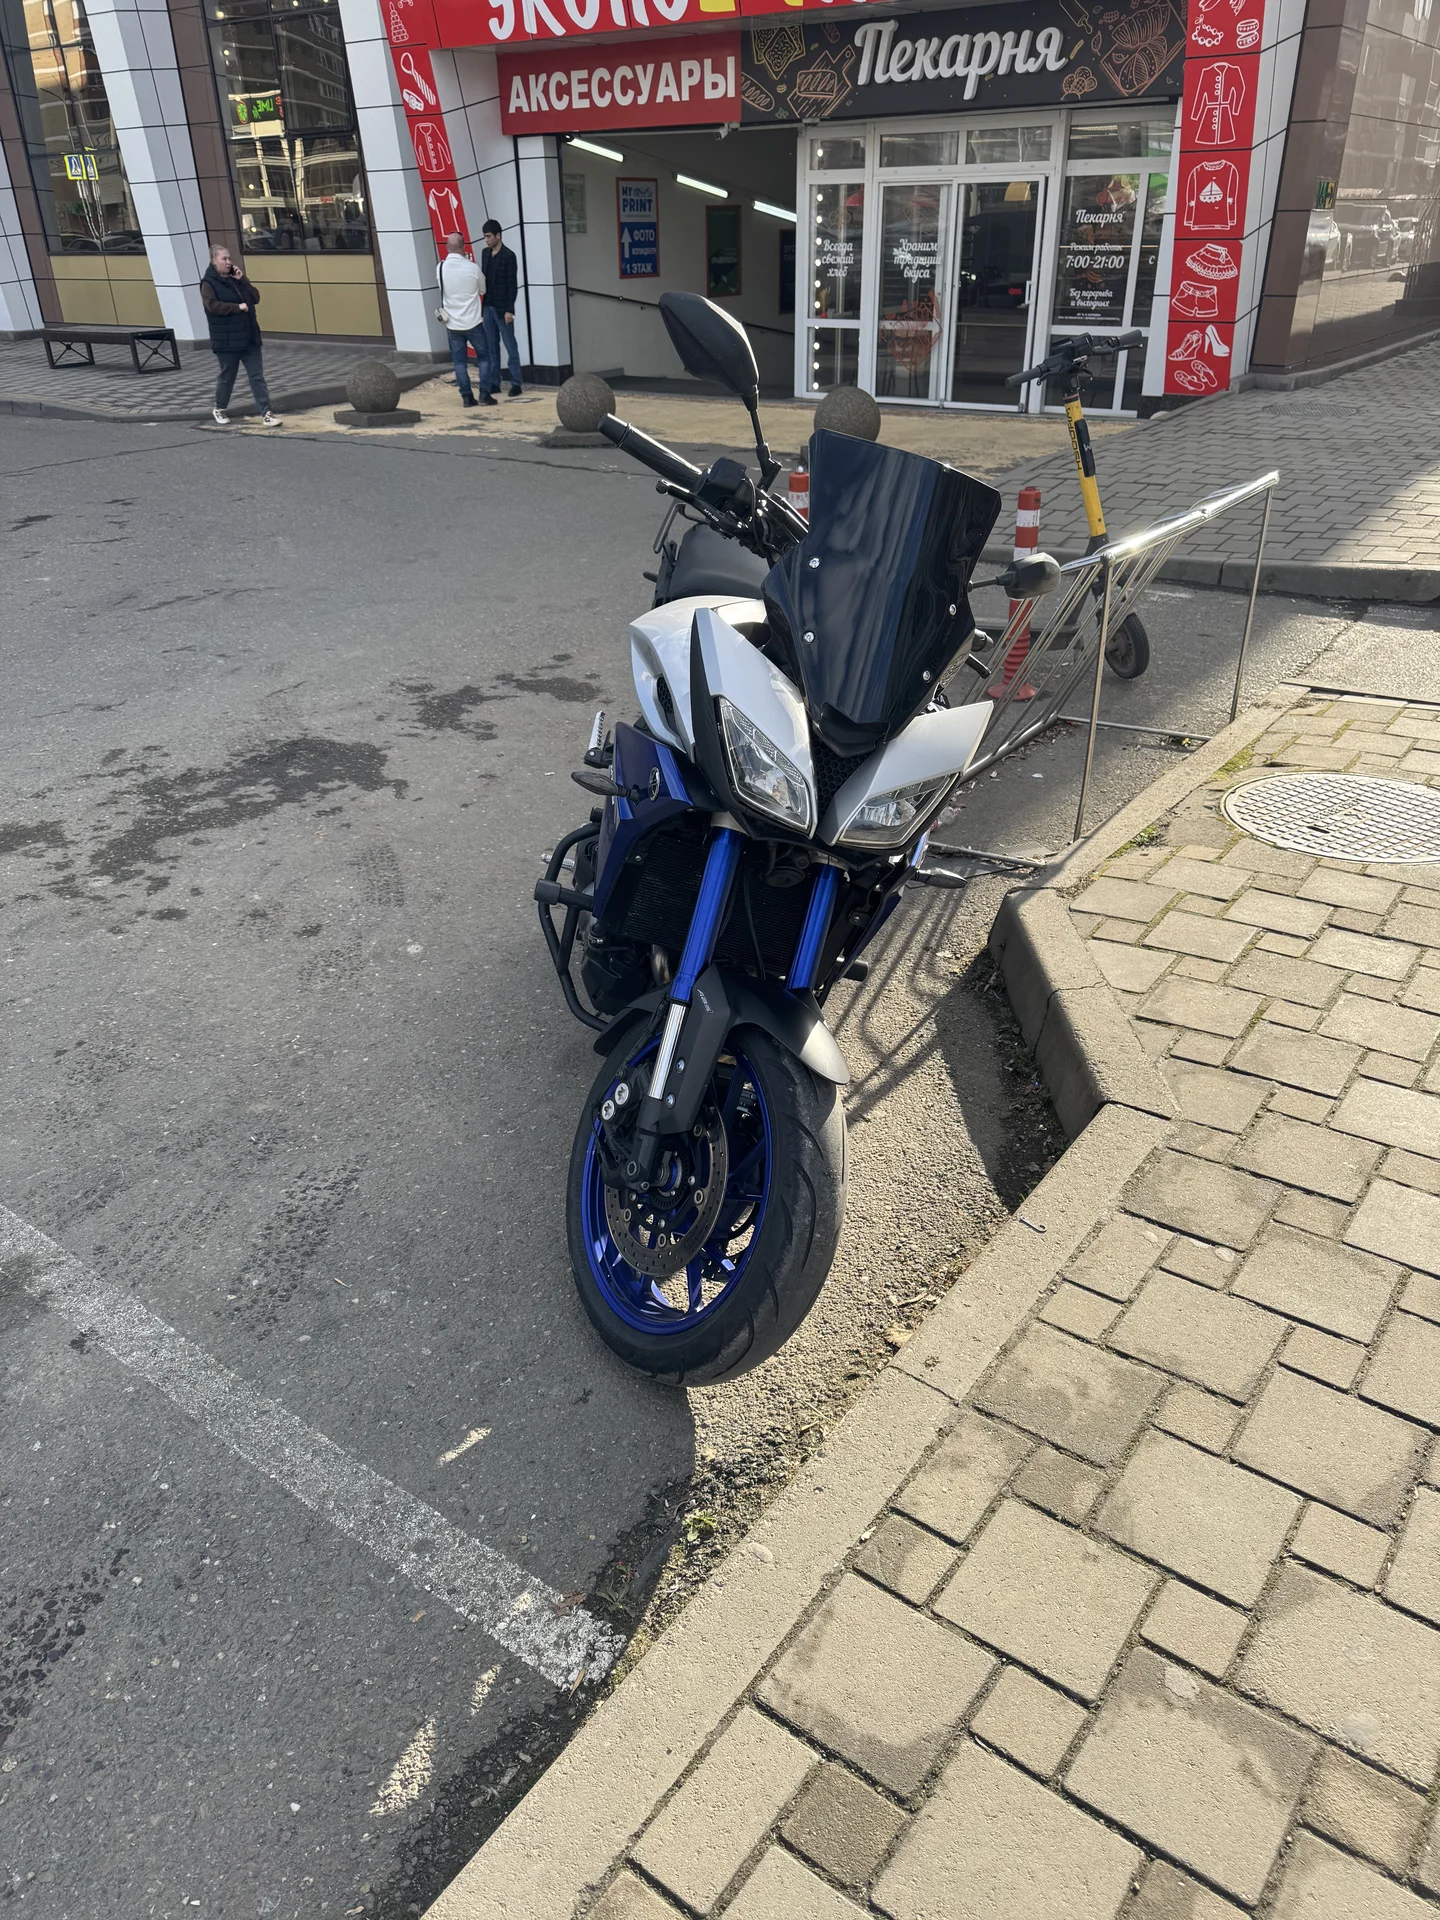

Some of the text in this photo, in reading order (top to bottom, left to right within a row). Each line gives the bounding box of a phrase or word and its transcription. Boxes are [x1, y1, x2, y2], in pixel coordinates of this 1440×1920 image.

[854, 19, 1069, 100] Пекарня
[508, 56, 736, 114] АКСЕССУАРЫ
[622, 198, 653, 212] PRINT
[1076, 209, 1124, 228] Пекарня
[633, 230, 655, 241] ФОТО
[823, 239, 853, 255] Всегда
[900, 239, 938, 253] Храним
[821, 253, 854, 265] свежий
[1065, 255, 1125, 269] 7:00-21:00
[626, 262, 653, 274] 1 ЭТАЖ
[827, 266, 848, 277] хлеб
[903, 267, 930, 283] вкуса
[1069, 288, 1113, 300] Без перерыва
[1076, 299, 1110, 310] выходных
[1065, 407, 1083, 470] WHOOSH
